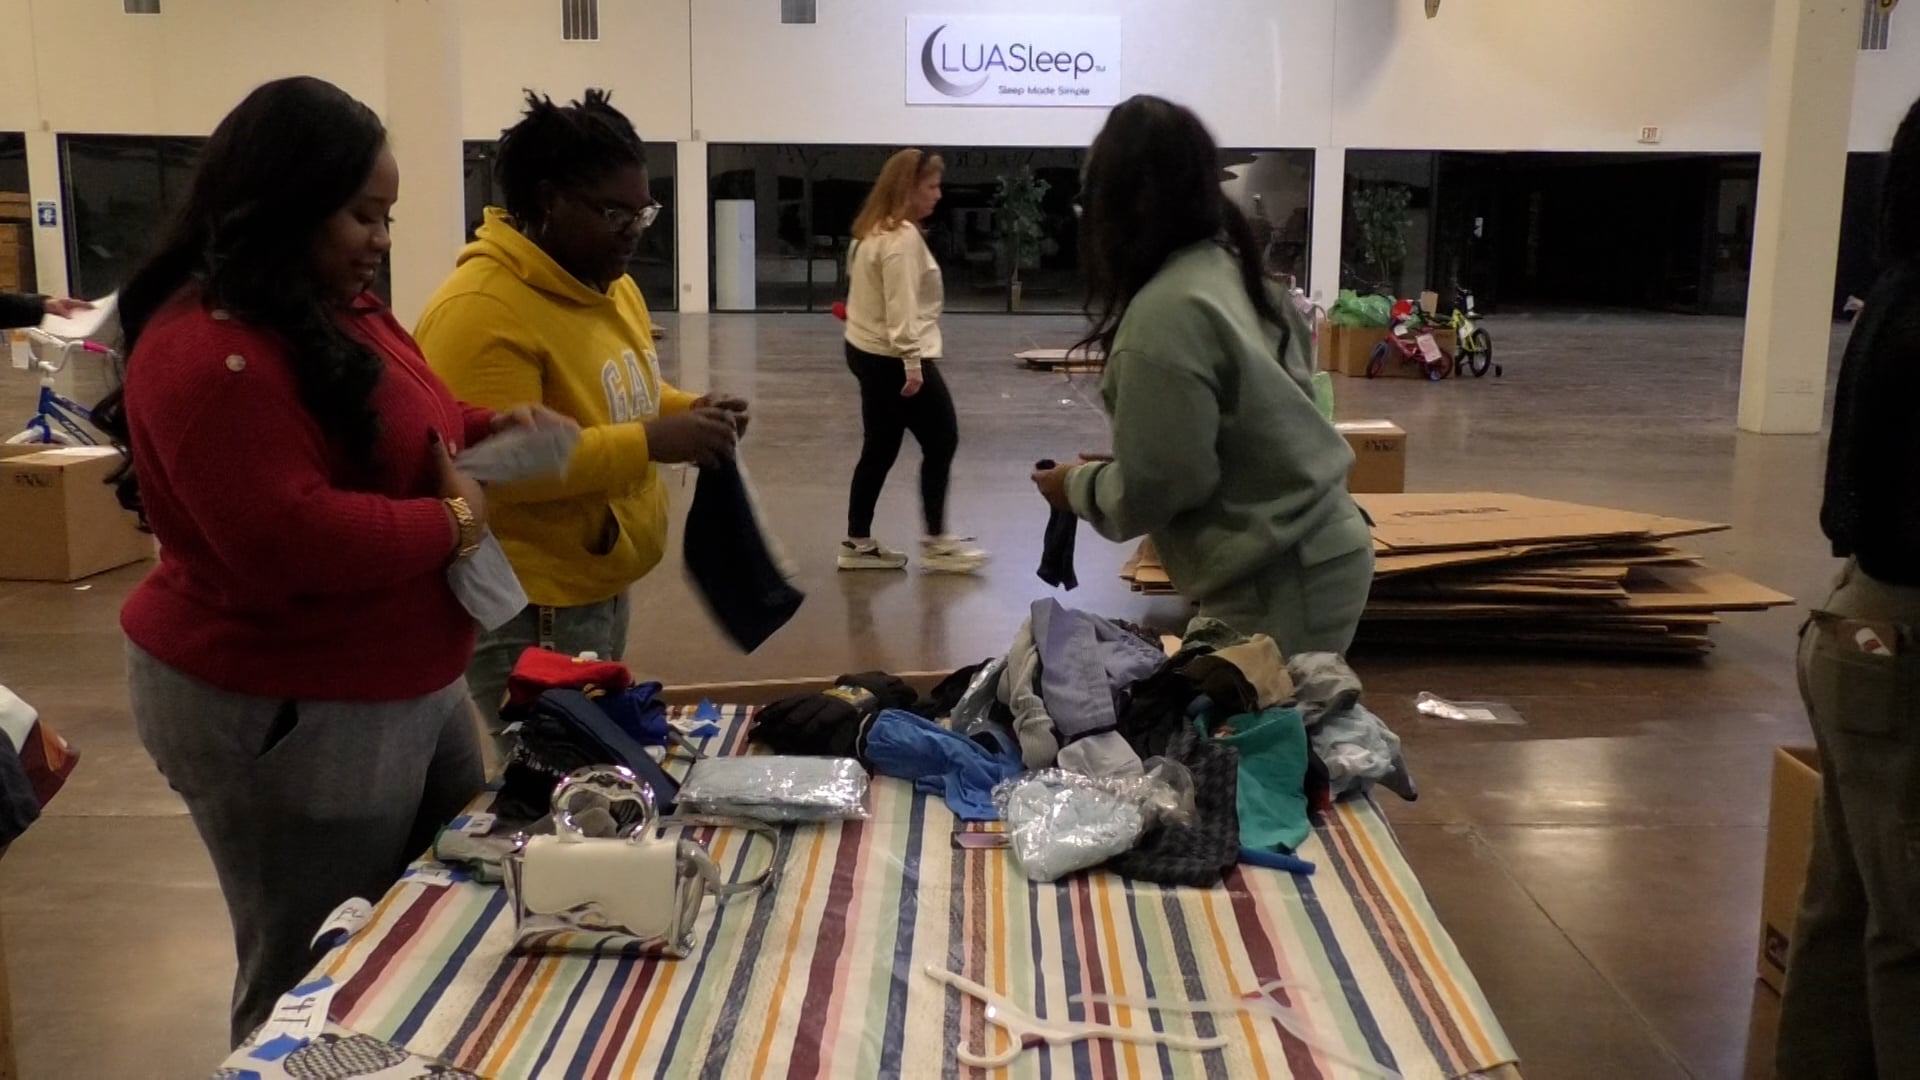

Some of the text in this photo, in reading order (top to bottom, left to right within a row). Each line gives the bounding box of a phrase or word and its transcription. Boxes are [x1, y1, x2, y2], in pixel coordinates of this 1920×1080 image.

[998, 85, 1090, 96] Sleep Made Simple
